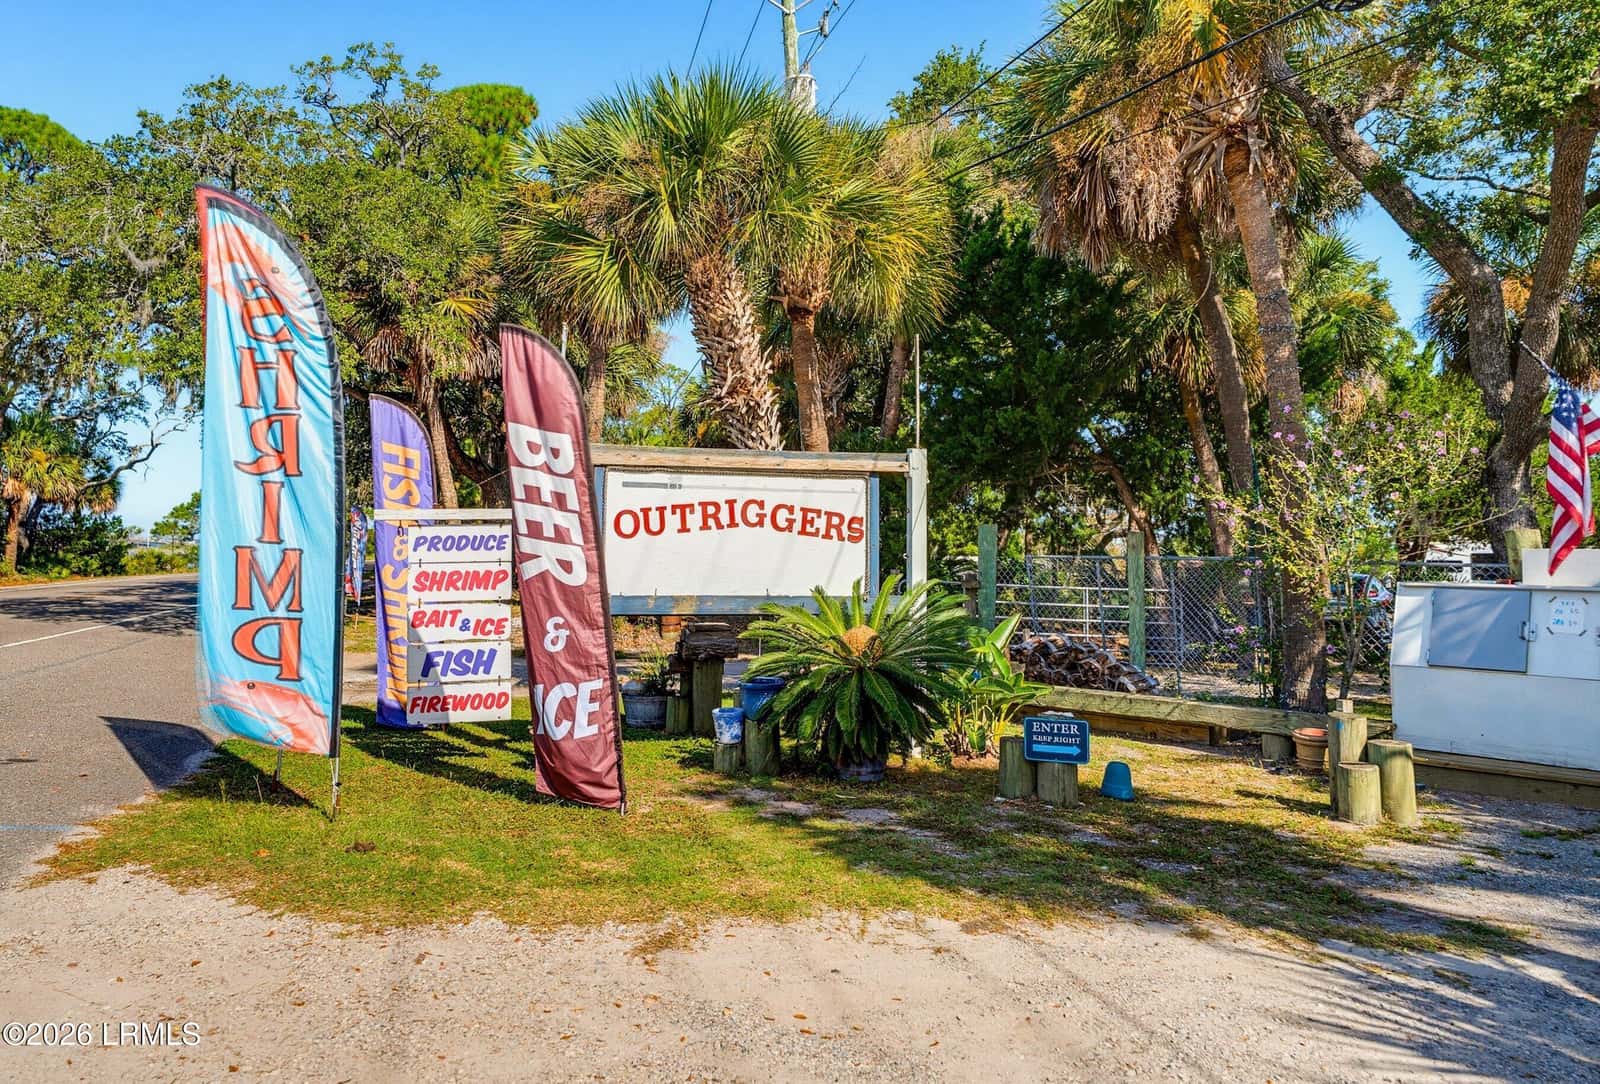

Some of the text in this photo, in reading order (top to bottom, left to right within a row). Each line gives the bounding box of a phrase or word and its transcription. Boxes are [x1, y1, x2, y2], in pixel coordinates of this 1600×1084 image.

[508, 422, 587, 587] BEER
[613, 499, 865, 544] OUTRIGGERS
[413, 534, 509, 552] PRODUCE
[413, 569, 509, 592] SHRIMP
[411, 610, 508, 636] BAIT & ICE
[544, 616, 570, 652] &
[421, 648, 497, 678] FISH
[409, 692, 509, 714] FIREWOOD
[534, 679, 603, 741] ICE
[1032, 722, 1080, 734] ENTER
